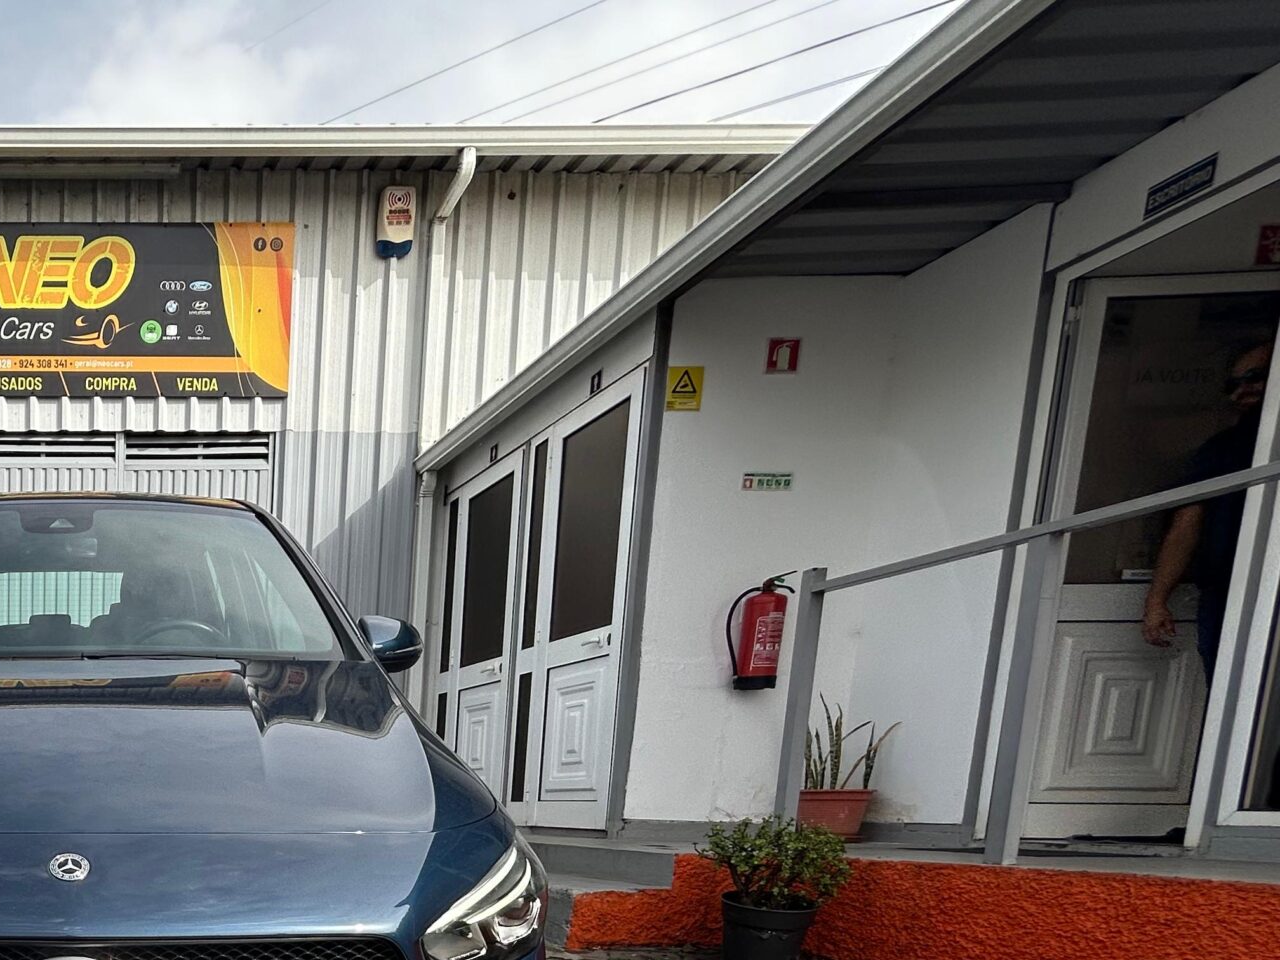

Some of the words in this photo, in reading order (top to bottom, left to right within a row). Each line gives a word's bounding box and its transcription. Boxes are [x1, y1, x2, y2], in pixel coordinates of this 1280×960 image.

[0, 316, 54, 340] Cars
[18, 359, 34, 369] 924
[36, 359, 51, 369] 308
[53, 359, 67, 369] 341
[85, 376, 137, 391] COMPRA
[176, 377, 219, 392] VENDA
